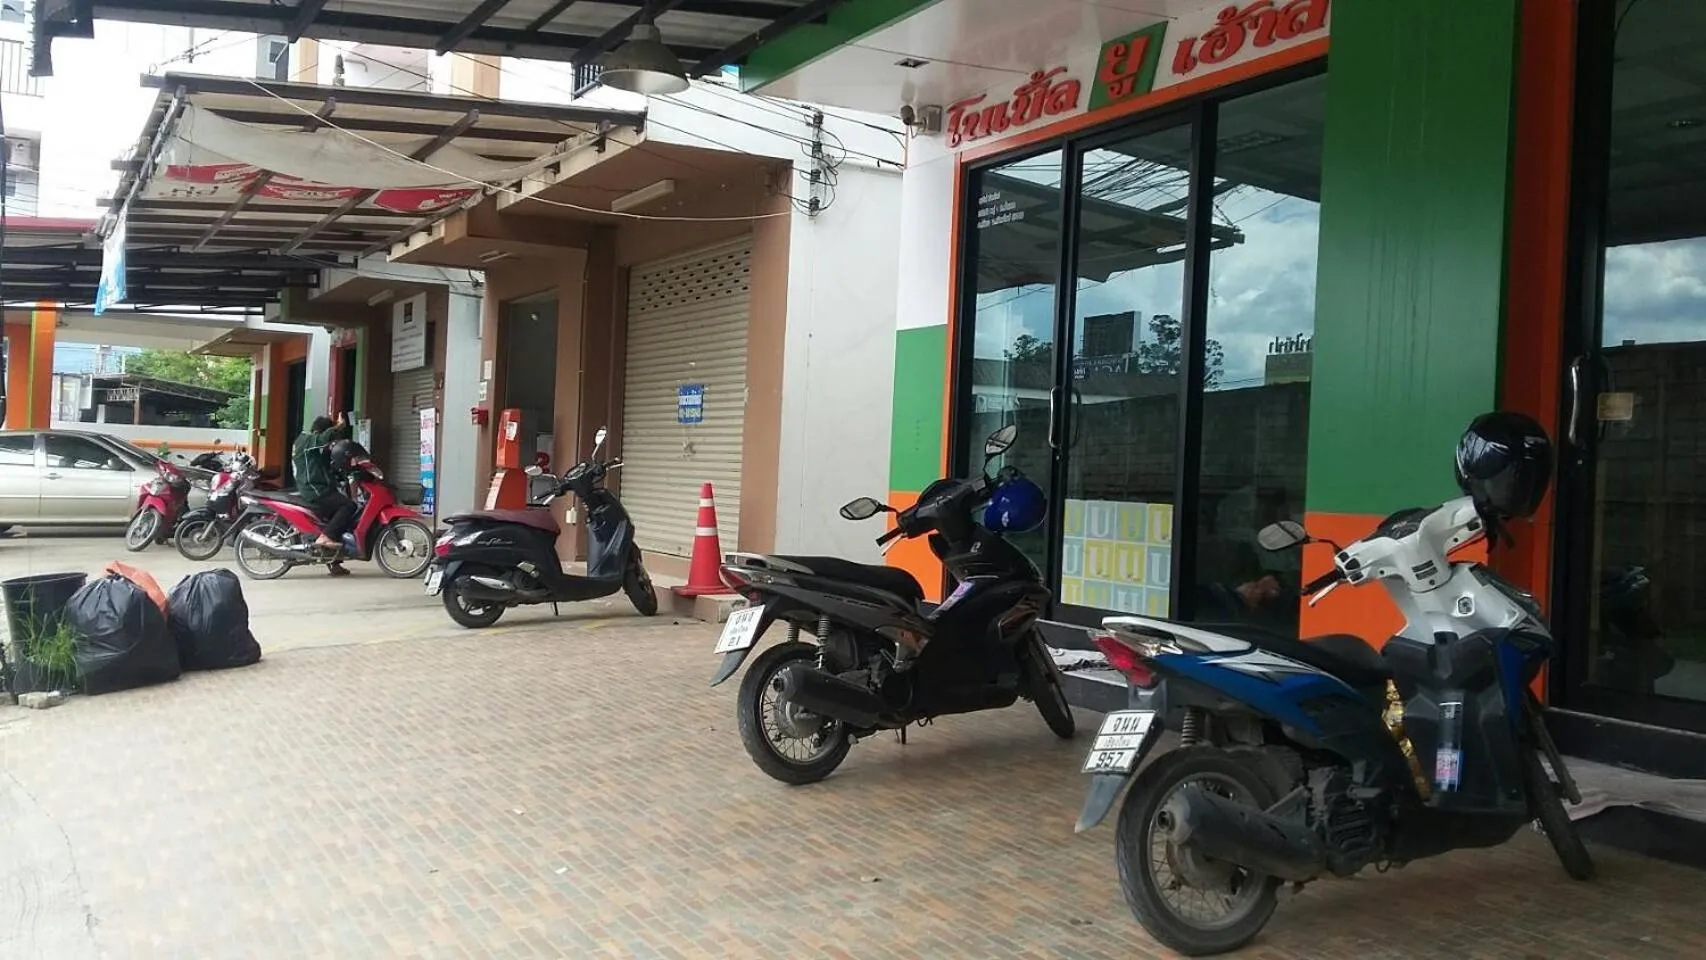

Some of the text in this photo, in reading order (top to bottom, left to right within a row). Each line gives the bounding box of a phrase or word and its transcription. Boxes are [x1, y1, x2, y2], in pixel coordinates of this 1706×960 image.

[1099, 33, 1150, 98] ยู
[1172, 0, 1329, 75] เฮ้าส
[1096, 751, 1125, 768] 957
